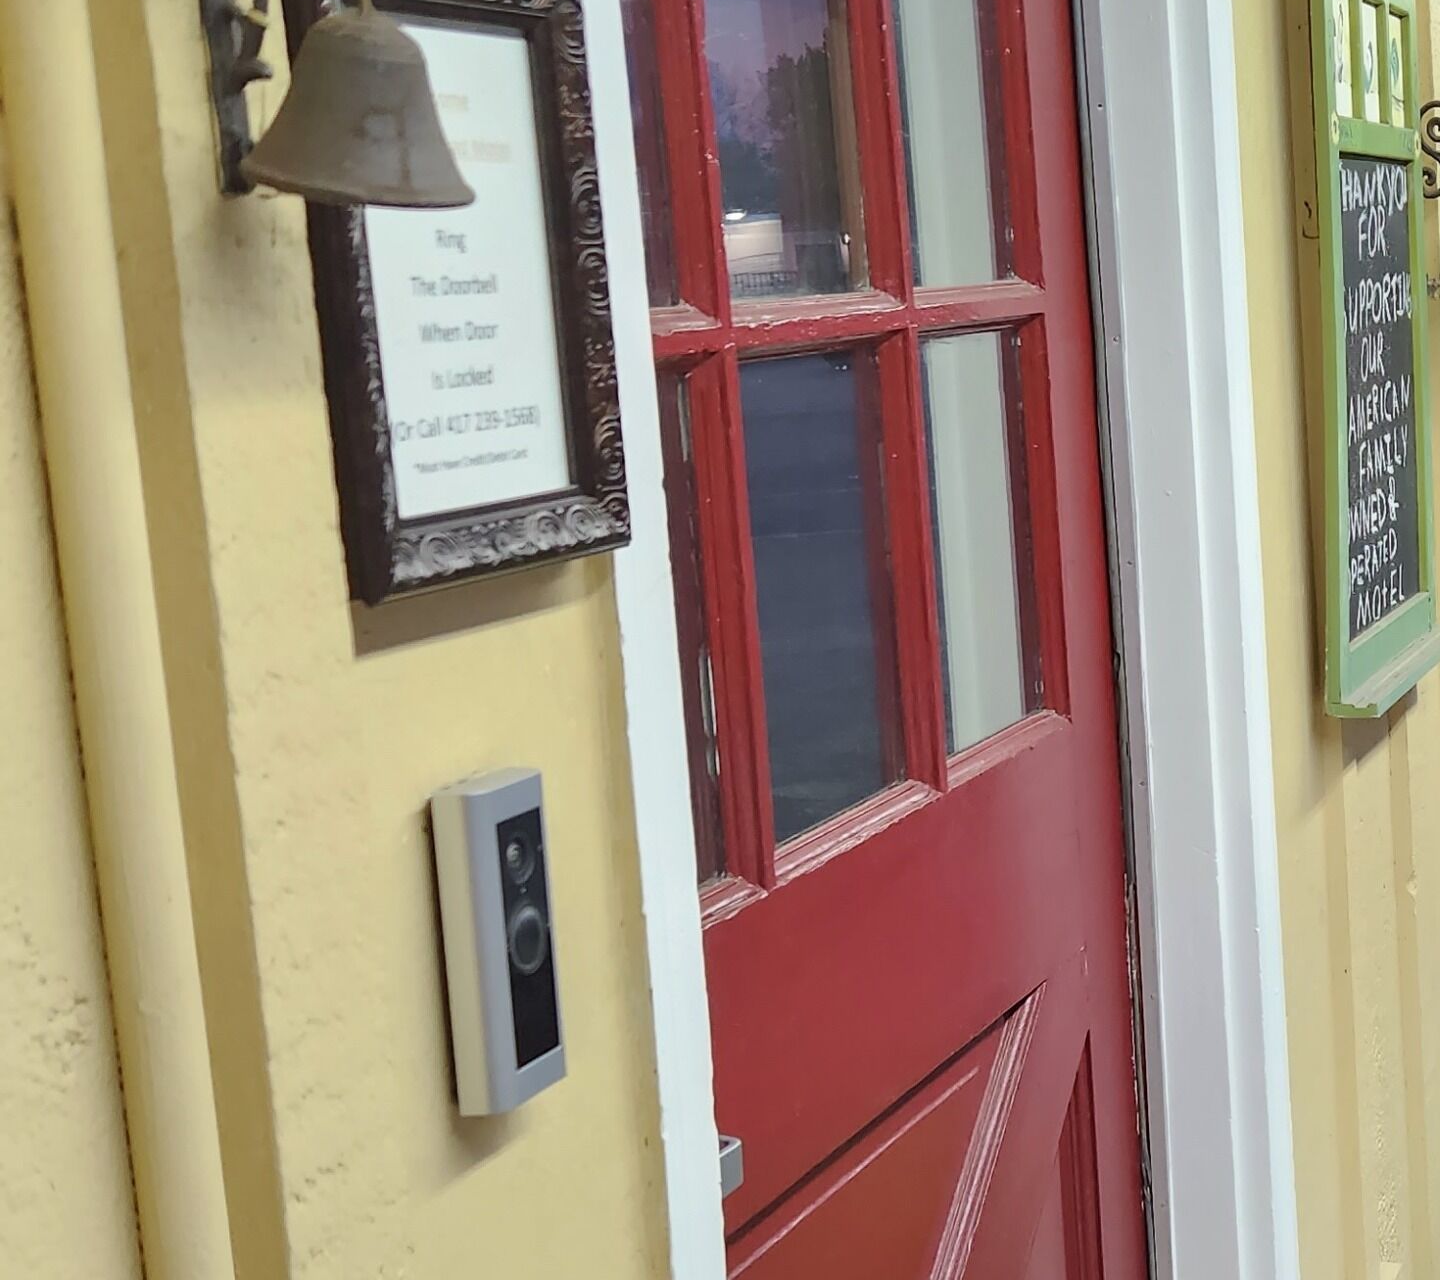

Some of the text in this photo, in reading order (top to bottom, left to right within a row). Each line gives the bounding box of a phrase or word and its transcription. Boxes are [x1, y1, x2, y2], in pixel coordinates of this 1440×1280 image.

[435, 229, 467, 254] Ring
[1358, 205, 1386, 261] FOR
[410, 273, 497, 297] The Doorbell
[1344, 271, 1412, 338] UPPORTING
[420, 321, 498, 343] When Door
[1360, 328, 1385, 382] OUR
[431, 364, 496, 390] Is Locked
[1348, 373, 1411, 447] AMERICAN
[1359, 423, 1408, 494] FAMILY
[1349, 476, 1400, 543] WNED &
[1349, 527, 1398, 595] PERATED
